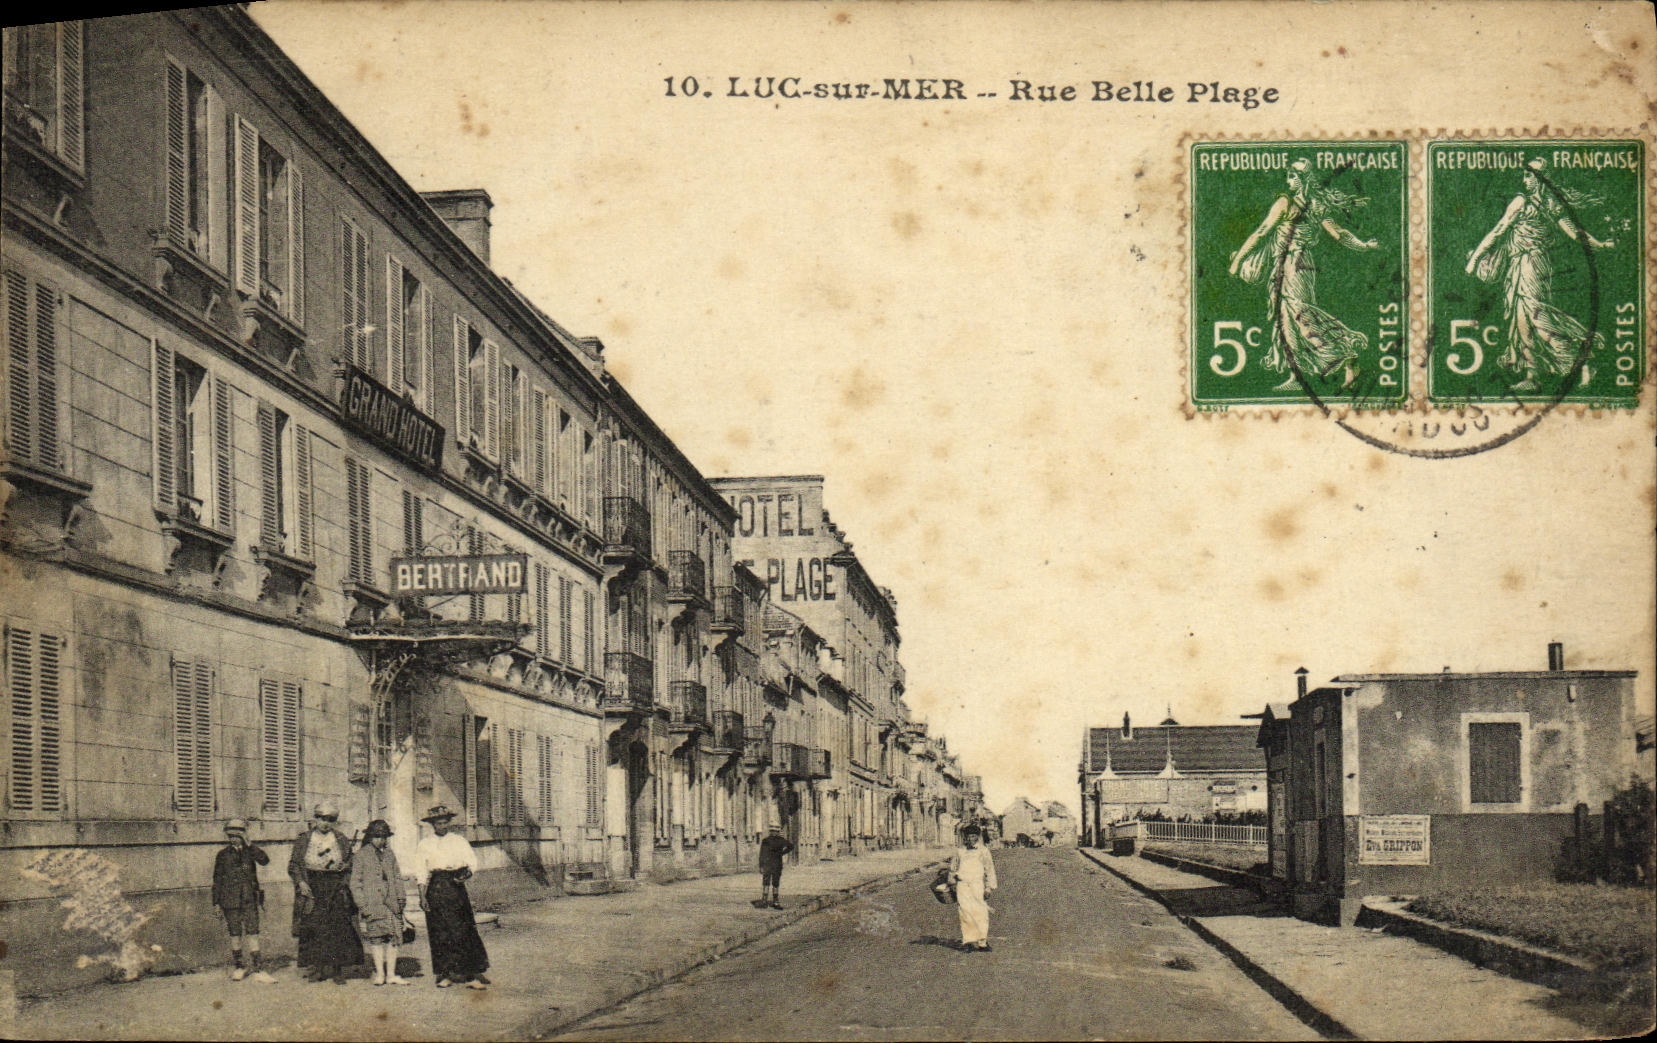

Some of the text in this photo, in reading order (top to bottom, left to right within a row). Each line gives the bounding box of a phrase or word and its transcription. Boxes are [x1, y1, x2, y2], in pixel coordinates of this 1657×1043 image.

[1316, 151, 1398, 172] FRANÇAISE
[1553, 151, 1638, 171] FRANÇAISE
[1378, 302, 1399, 386] POSTES
[1616, 302, 1636, 386] POSTES
[350, 376, 436, 466] GRAND HOTEL
[397, 562, 522, 590] BERTRAND
[767, 557, 837, 601] PLAGE
